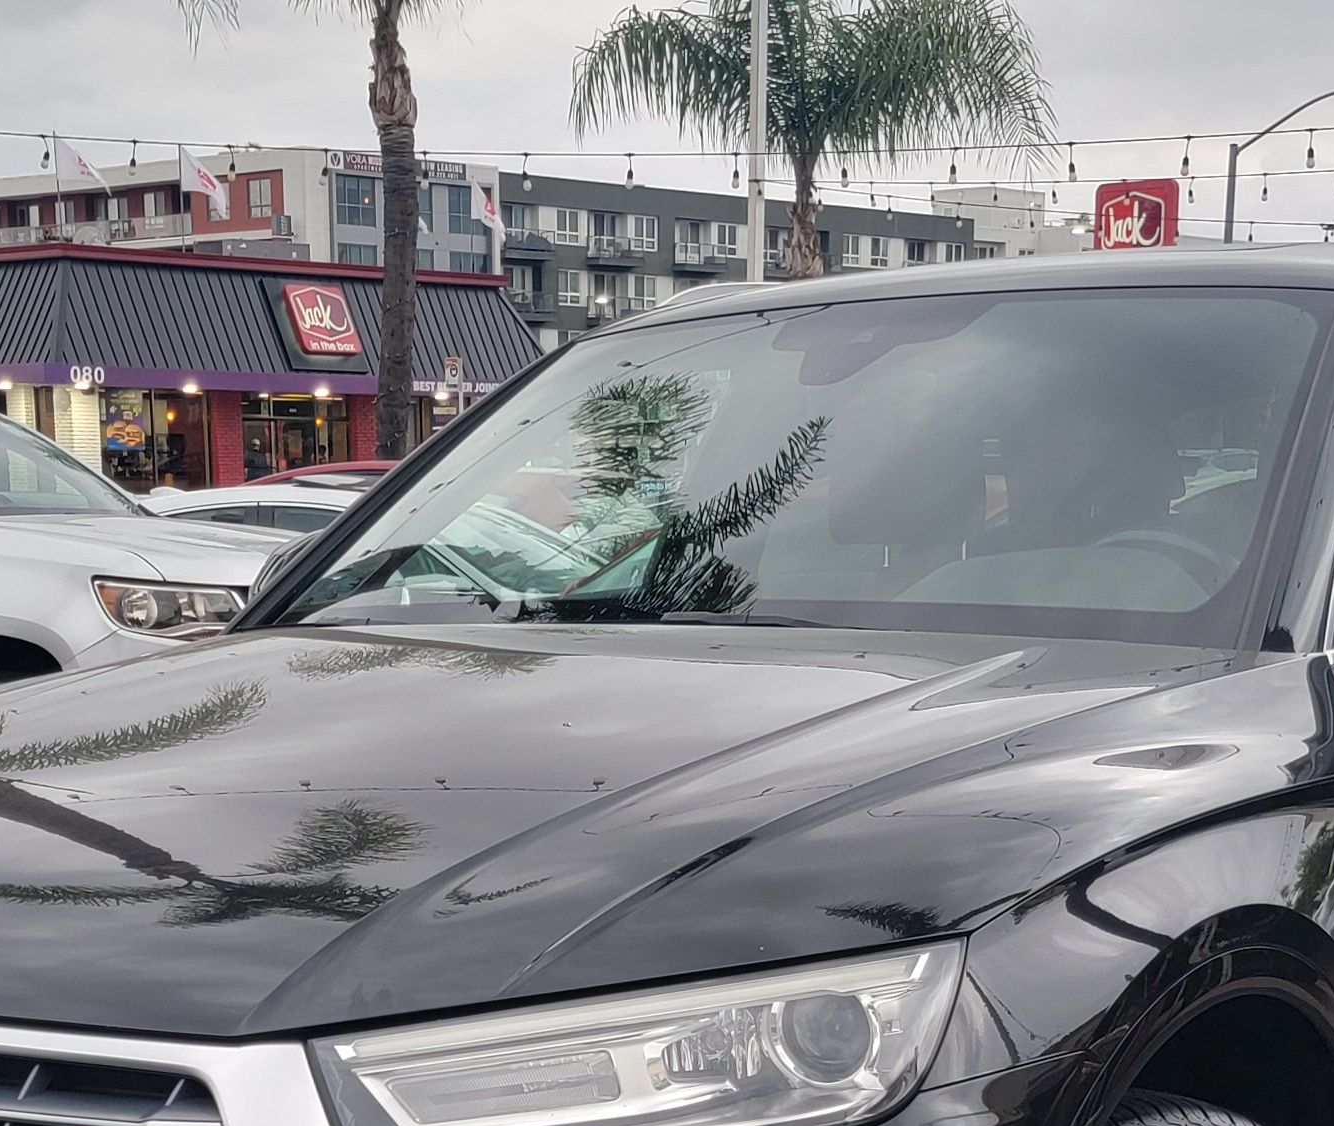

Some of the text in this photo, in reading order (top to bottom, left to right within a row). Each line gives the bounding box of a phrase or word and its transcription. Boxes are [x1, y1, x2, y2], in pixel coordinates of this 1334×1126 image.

[345, 154, 367, 165] VORA
[436, 162, 463, 174] LEASING
[1104, 200, 1160, 247] Jack
[295, 294, 347, 331] Jack
[310, 340, 356, 351] in the box
[70, 365, 105, 385] 080
[412, 381, 436, 392] BEST
